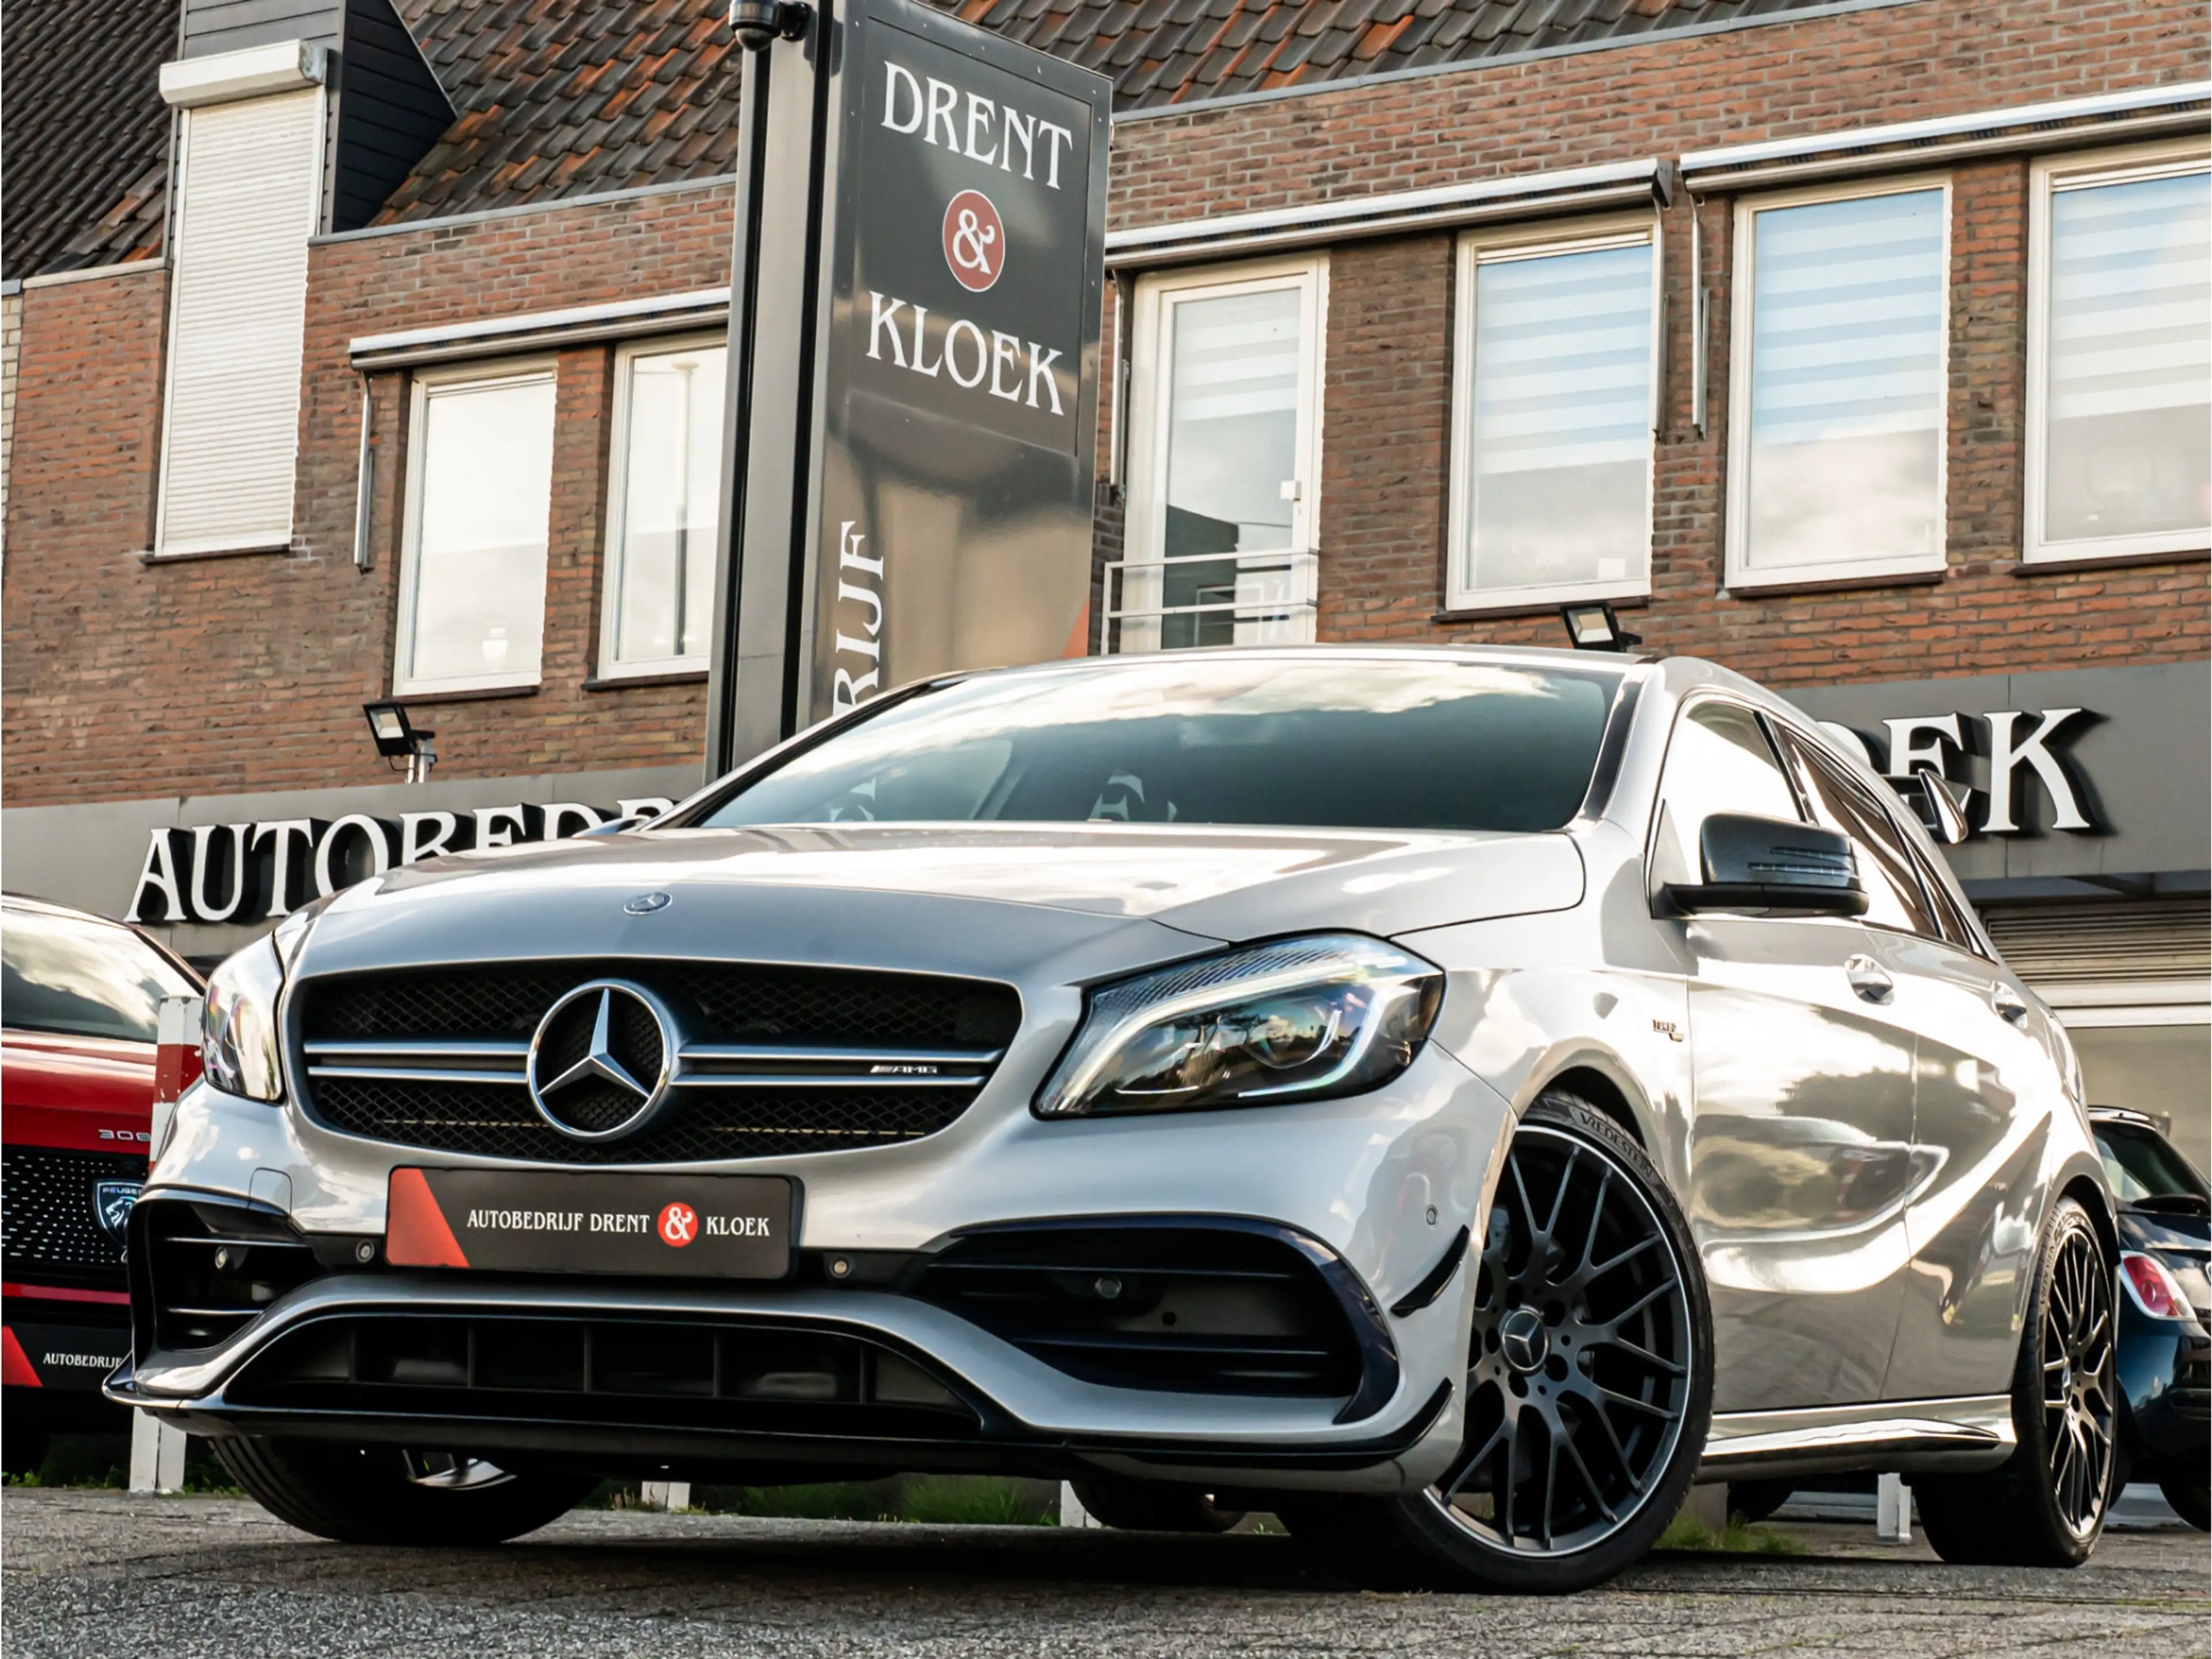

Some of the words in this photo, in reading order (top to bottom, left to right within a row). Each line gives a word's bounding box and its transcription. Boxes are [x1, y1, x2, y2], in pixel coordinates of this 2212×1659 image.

[881, 60, 1073, 190] DRENT
[952, 209, 995, 274] &
[866, 291, 1064, 416] KLOEK
[124, 798, 676, 922] AUTOBE
[1580, 1111, 1653, 1179] VREDESTEIN
[467, 1209, 584, 1232] AUTOBEDRIJF
[590, 1213, 650, 1233] DRENT
[665, 1206, 694, 1240] &
[706, 1215, 770, 1237] KLOEK
